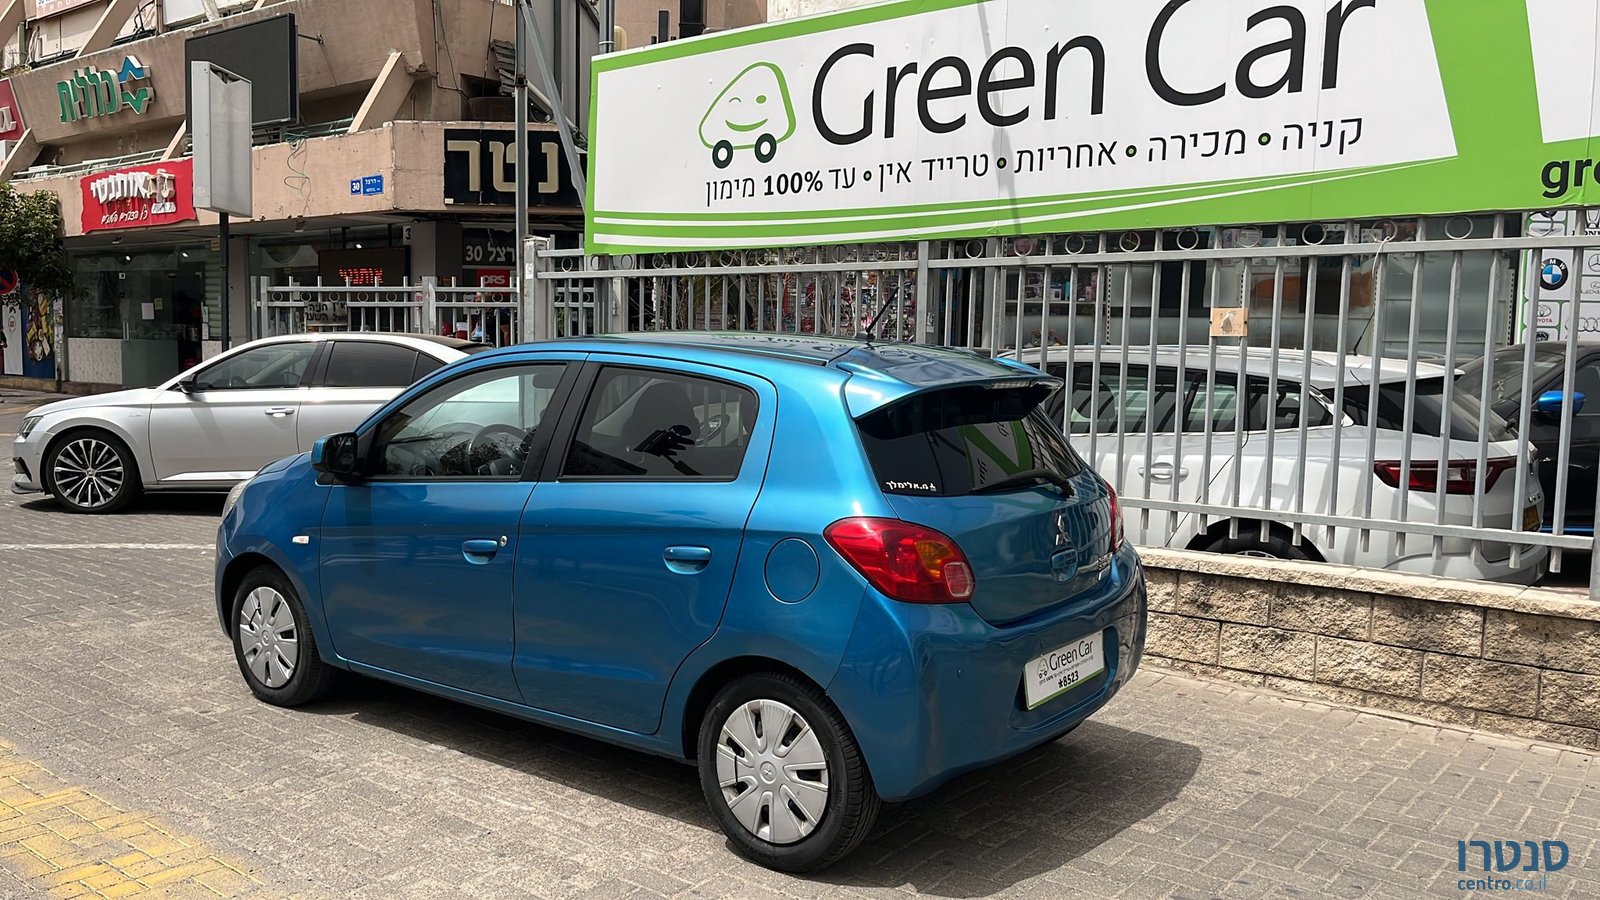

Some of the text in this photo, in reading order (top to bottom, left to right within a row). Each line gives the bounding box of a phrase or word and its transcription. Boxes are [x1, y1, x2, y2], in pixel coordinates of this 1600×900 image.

[812, 0, 1376, 145] Green Car
[57, 66, 120, 124] כללית
[705, 117, 1363, 207] קניה מכירה אחריות טרייד אין עד 100% מימון
[351, 182, 360, 192] 30
[465, 242, 516, 262] רצל 30
[1049, 648, 1078, 671] Green
[1078, 640, 1094, 658] Car
